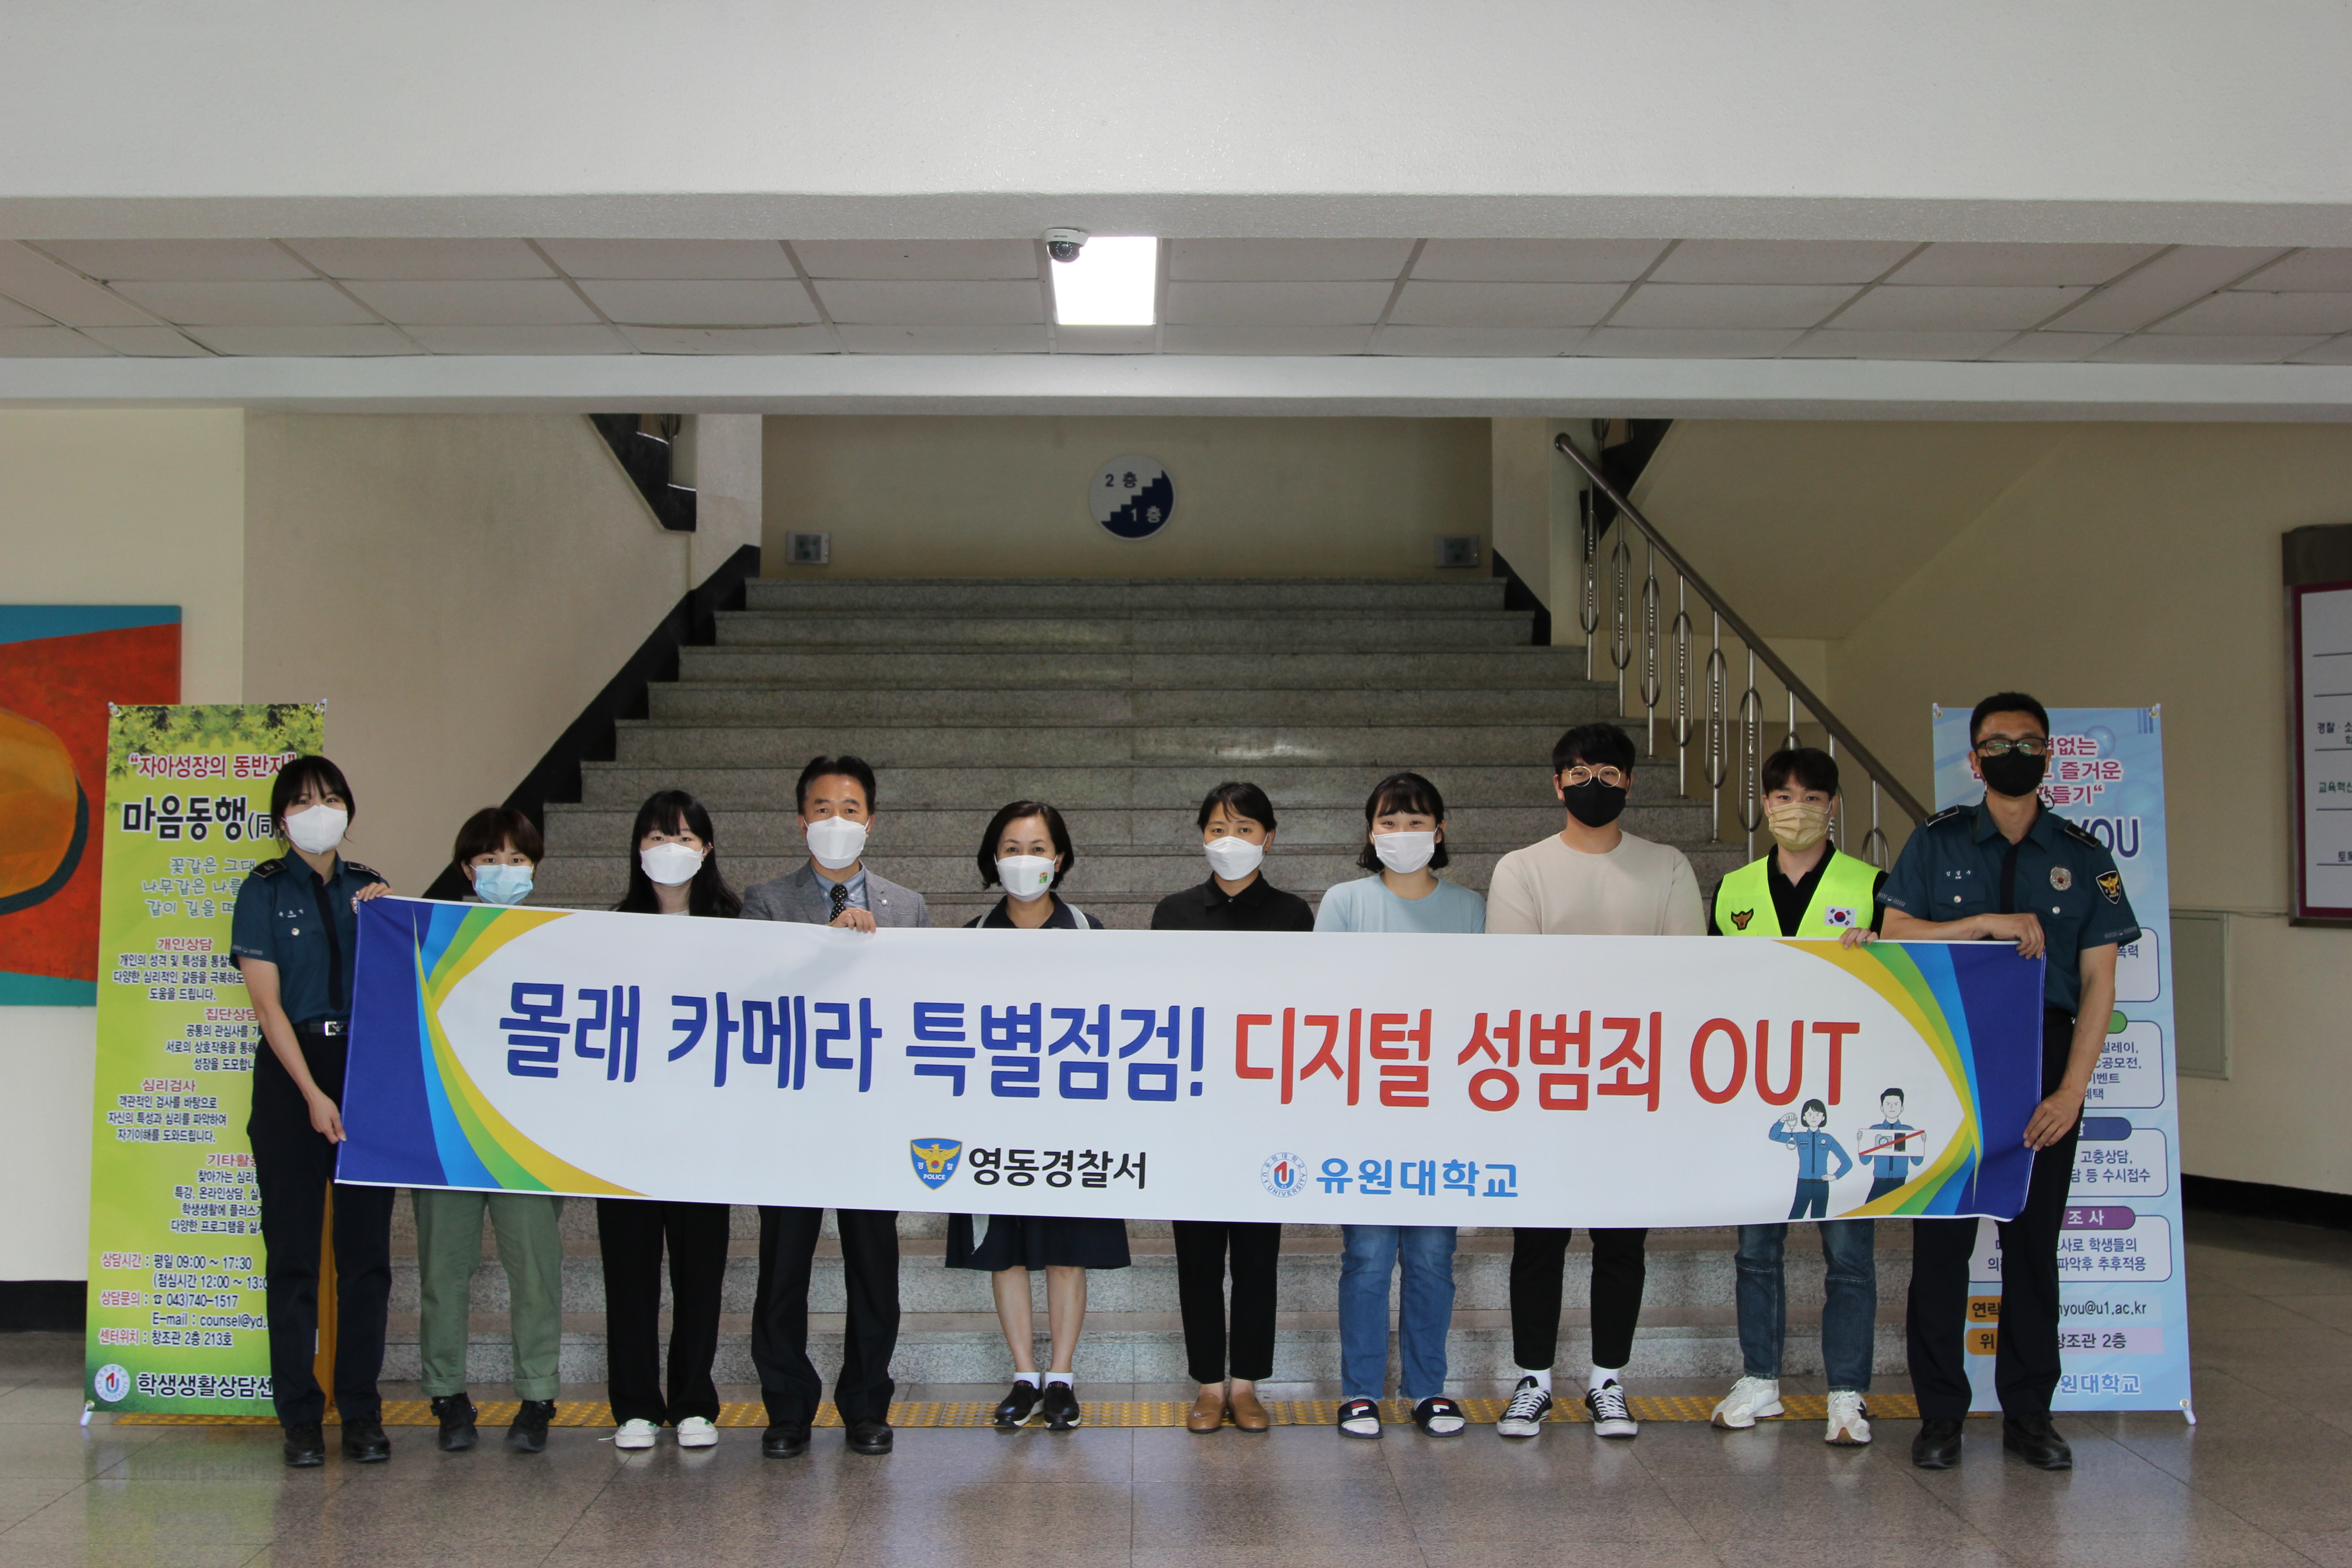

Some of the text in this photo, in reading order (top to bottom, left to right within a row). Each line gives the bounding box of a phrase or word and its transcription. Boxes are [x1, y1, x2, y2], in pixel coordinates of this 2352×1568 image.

[2060, 761, 2122, 780] 즐거운
[171, 857, 217, 874] 꽃같은
[142, 878, 206, 896] 나무같은
[146, 900, 177, 916] 같이
[184, 899, 216, 916] 길을
[157, 938, 213, 952] 개인상담
[119, 955, 146, 967] 개인의
[149, 955, 167, 968] 성격
[171, 955, 178, 967] 및
[182, 955, 207, 968] 특성을
[113, 971, 140, 984] 다양한
[144, 971, 178, 984] 심리적인
[181, 971, 207, 984] 갈등을
[150, 987, 216, 1000] 도움을 드립니다.
[186, 1024, 211, 1037] 공통의
[215, 1024, 248, 1038] 관심사를
[166, 1041, 191, 1054] 서로의
[194, 1041, 236, 1054] 상호작용을
[499, 982, 1860, 1112] 몰래 카메라 특별점검! 디지털 성범죄 OUT
[193, 1057, 219, 1071] 성장을
[142, 1078, 196, 1093] 심리검사
[118, 1095, 218, 1109] 객관적인 검사를 바탕으로
[108, 1112, 227, 1126] 자신의 특성과 심리를 파악하여
[117, 1128, 216, 1143] 자기이해를 도와드립니다.
[2080, 1149, 2132, 1165] 고충상담,
[969, 1147, 1146, 1189] 영동경찰서
[2086, 1169, 2098, 1183] 등
[2102, 1168, 2151, 1183] 수시접수
[198, 1169, 233, 1183] 찾아가는
[1316, 1158, 1519, 1197] 유원대학교
[175, 1186, 195, 1199] 특강,
[198, 1186, 246, 1201] 온라인상담,
[181, 1202, 227, 1217] 학생생활에
[171, 1219, 198, 1232] 다양한
[201, 1220, 245, 1234] 프로그램을
[2089, 1238, 2137, 1252] 학생들의
[102, 1253, 142, 1269] 상담시간
[154, 1254, 173, 1269] 평일
[176, 1255, 206, 1269] 09:00
[223, 1256, 252, 1270] 17:30
[2098, 1257, 2146, 1272] 추후적용
[153, 1273, 197, 1289] (점심시간
[201, 1275, 230, 1289] 12:00
[101, 1291, 141, 1306] 상담문의
[99, 1328, 139, 1344] 센터위치
[152, 1330, 181, 1346] 창조관
[184, 1331, 201, 1346] 2층
[204, 1332, 233, 1347] 213호
[2102, 1333, 2127, 1349] 2층
[2055, 1374, 2139, 1394] 원대학교
